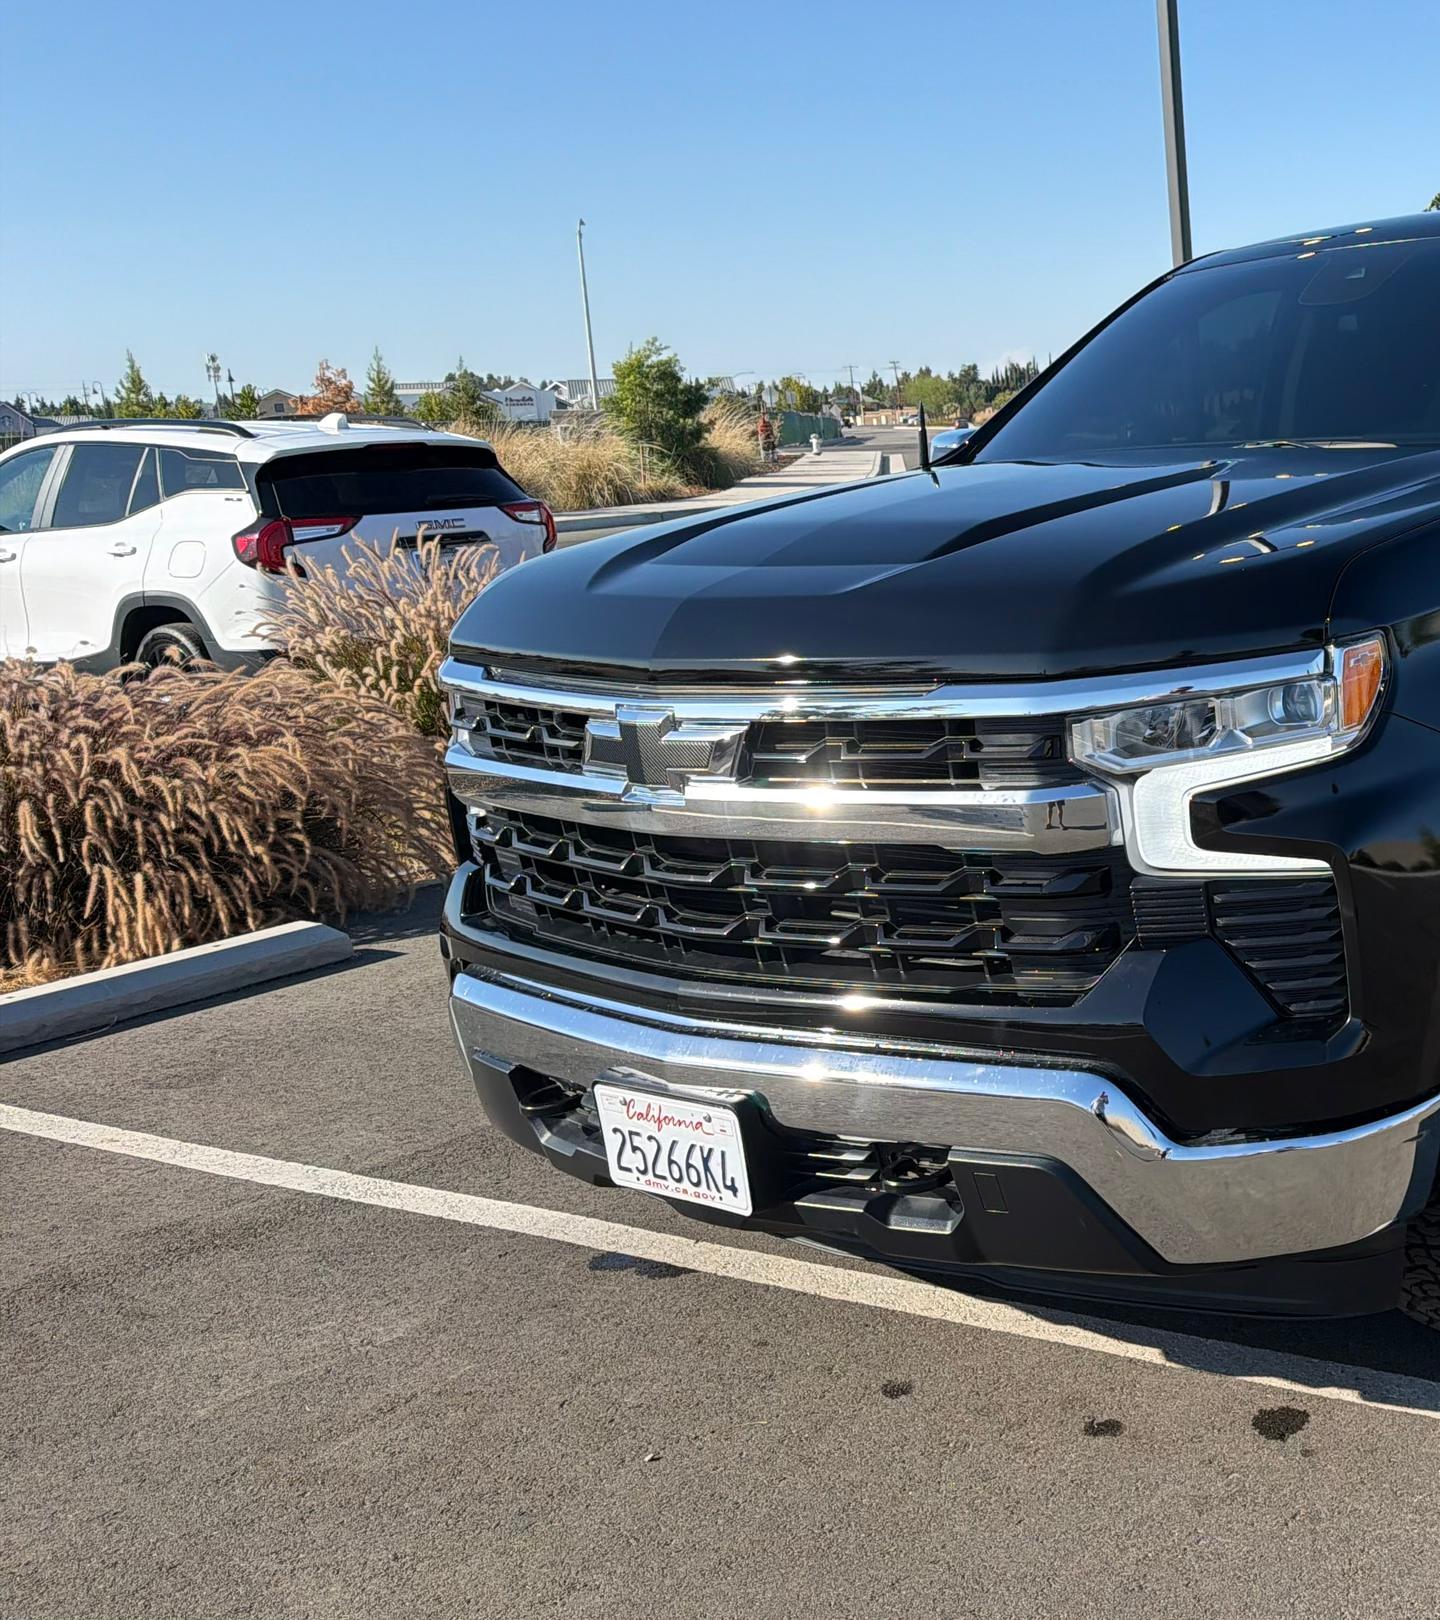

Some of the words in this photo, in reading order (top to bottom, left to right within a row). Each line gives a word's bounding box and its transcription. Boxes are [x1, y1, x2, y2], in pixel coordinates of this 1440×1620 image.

[415, 517, 467, 531] GMC
[624, 1097, 715, 1137] California
[612, 1126, 739, 1198] 25266K4
[644, 1178, 717, 1202] dmv.ca.gov
